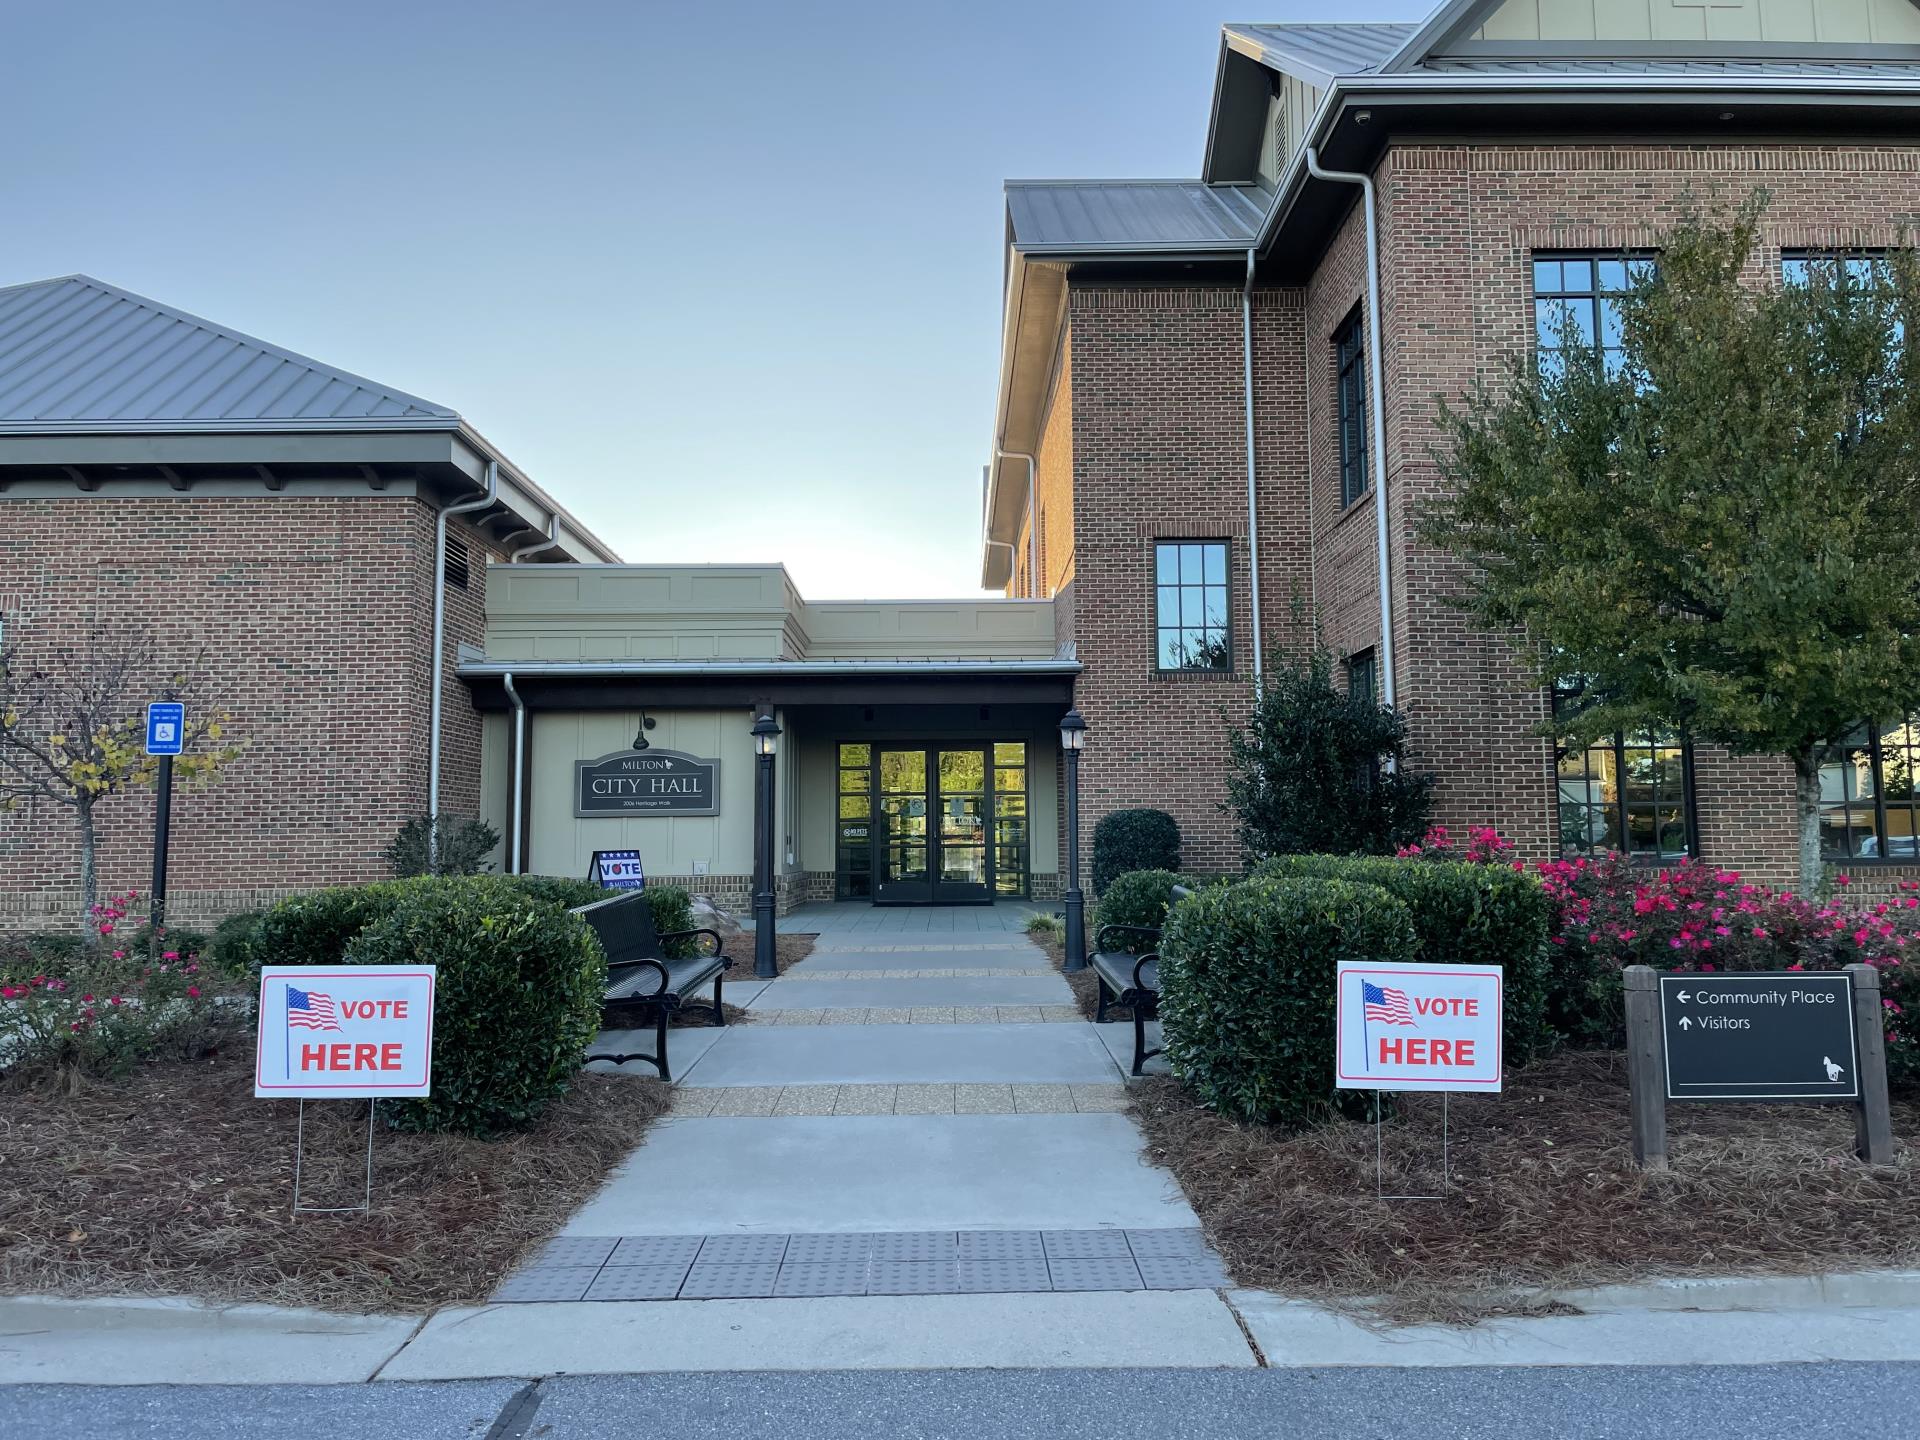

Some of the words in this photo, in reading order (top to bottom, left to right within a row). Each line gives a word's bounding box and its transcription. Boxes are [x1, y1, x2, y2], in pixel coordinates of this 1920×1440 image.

[622, 760, 664, 770] MILTON
[592, 778, 641, 793] CITY
[651, 778, 702, 793] HALL
[600, 862, 641, 875] VOTE
[1696, 990, 1787, 1006] Community
[1792, 990, 1835, 1004] Place
[341, 1001, 408, 1019] VOTE
[1414, 997, 1479, 1017] VOTE
[1697, 1016, 1751, 1029] Visitors
[301, 1043, 403, 1071] HERE
[1379, 1038, 1475, 1066] HERE
